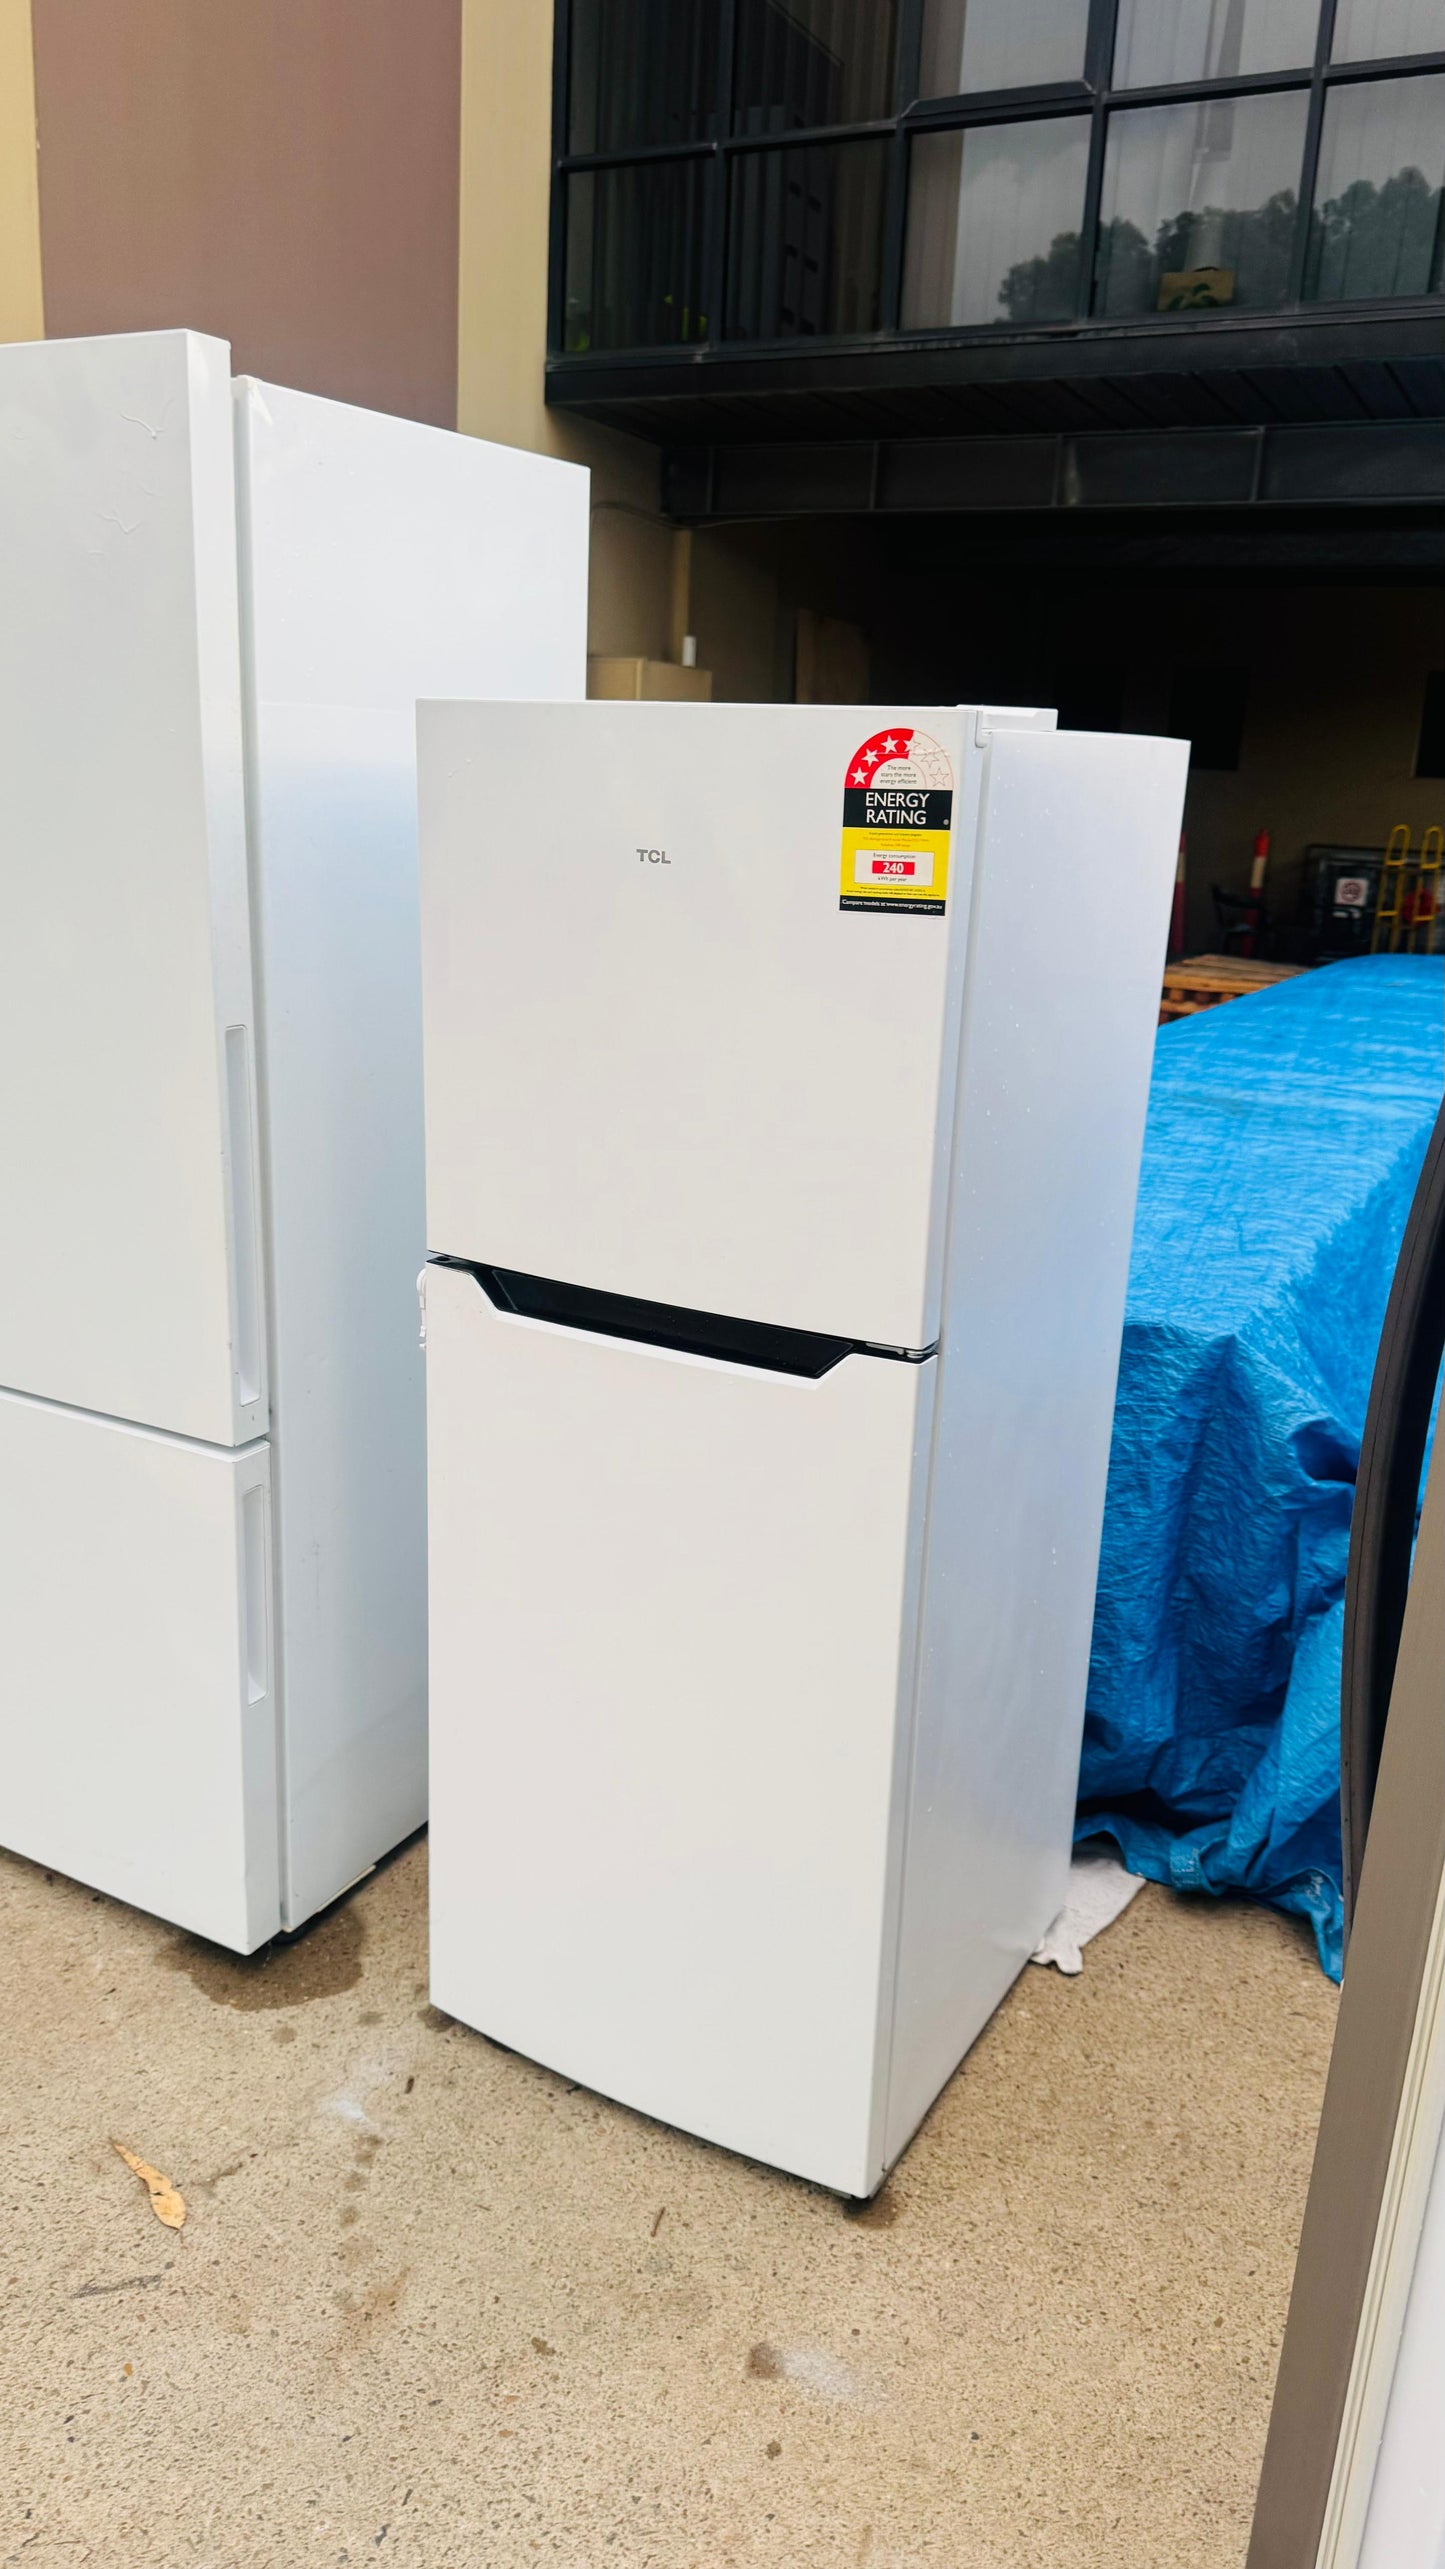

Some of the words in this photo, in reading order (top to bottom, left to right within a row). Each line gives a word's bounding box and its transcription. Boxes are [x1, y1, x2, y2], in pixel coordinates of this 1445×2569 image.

[865, 792, 930, 808] ENERGY
[866, 809, 927, 825] RATING
[636, 848, 672, 865] TCL
[873, 852, 888, 860] Energy
[882, 862, 904, 874] 240
